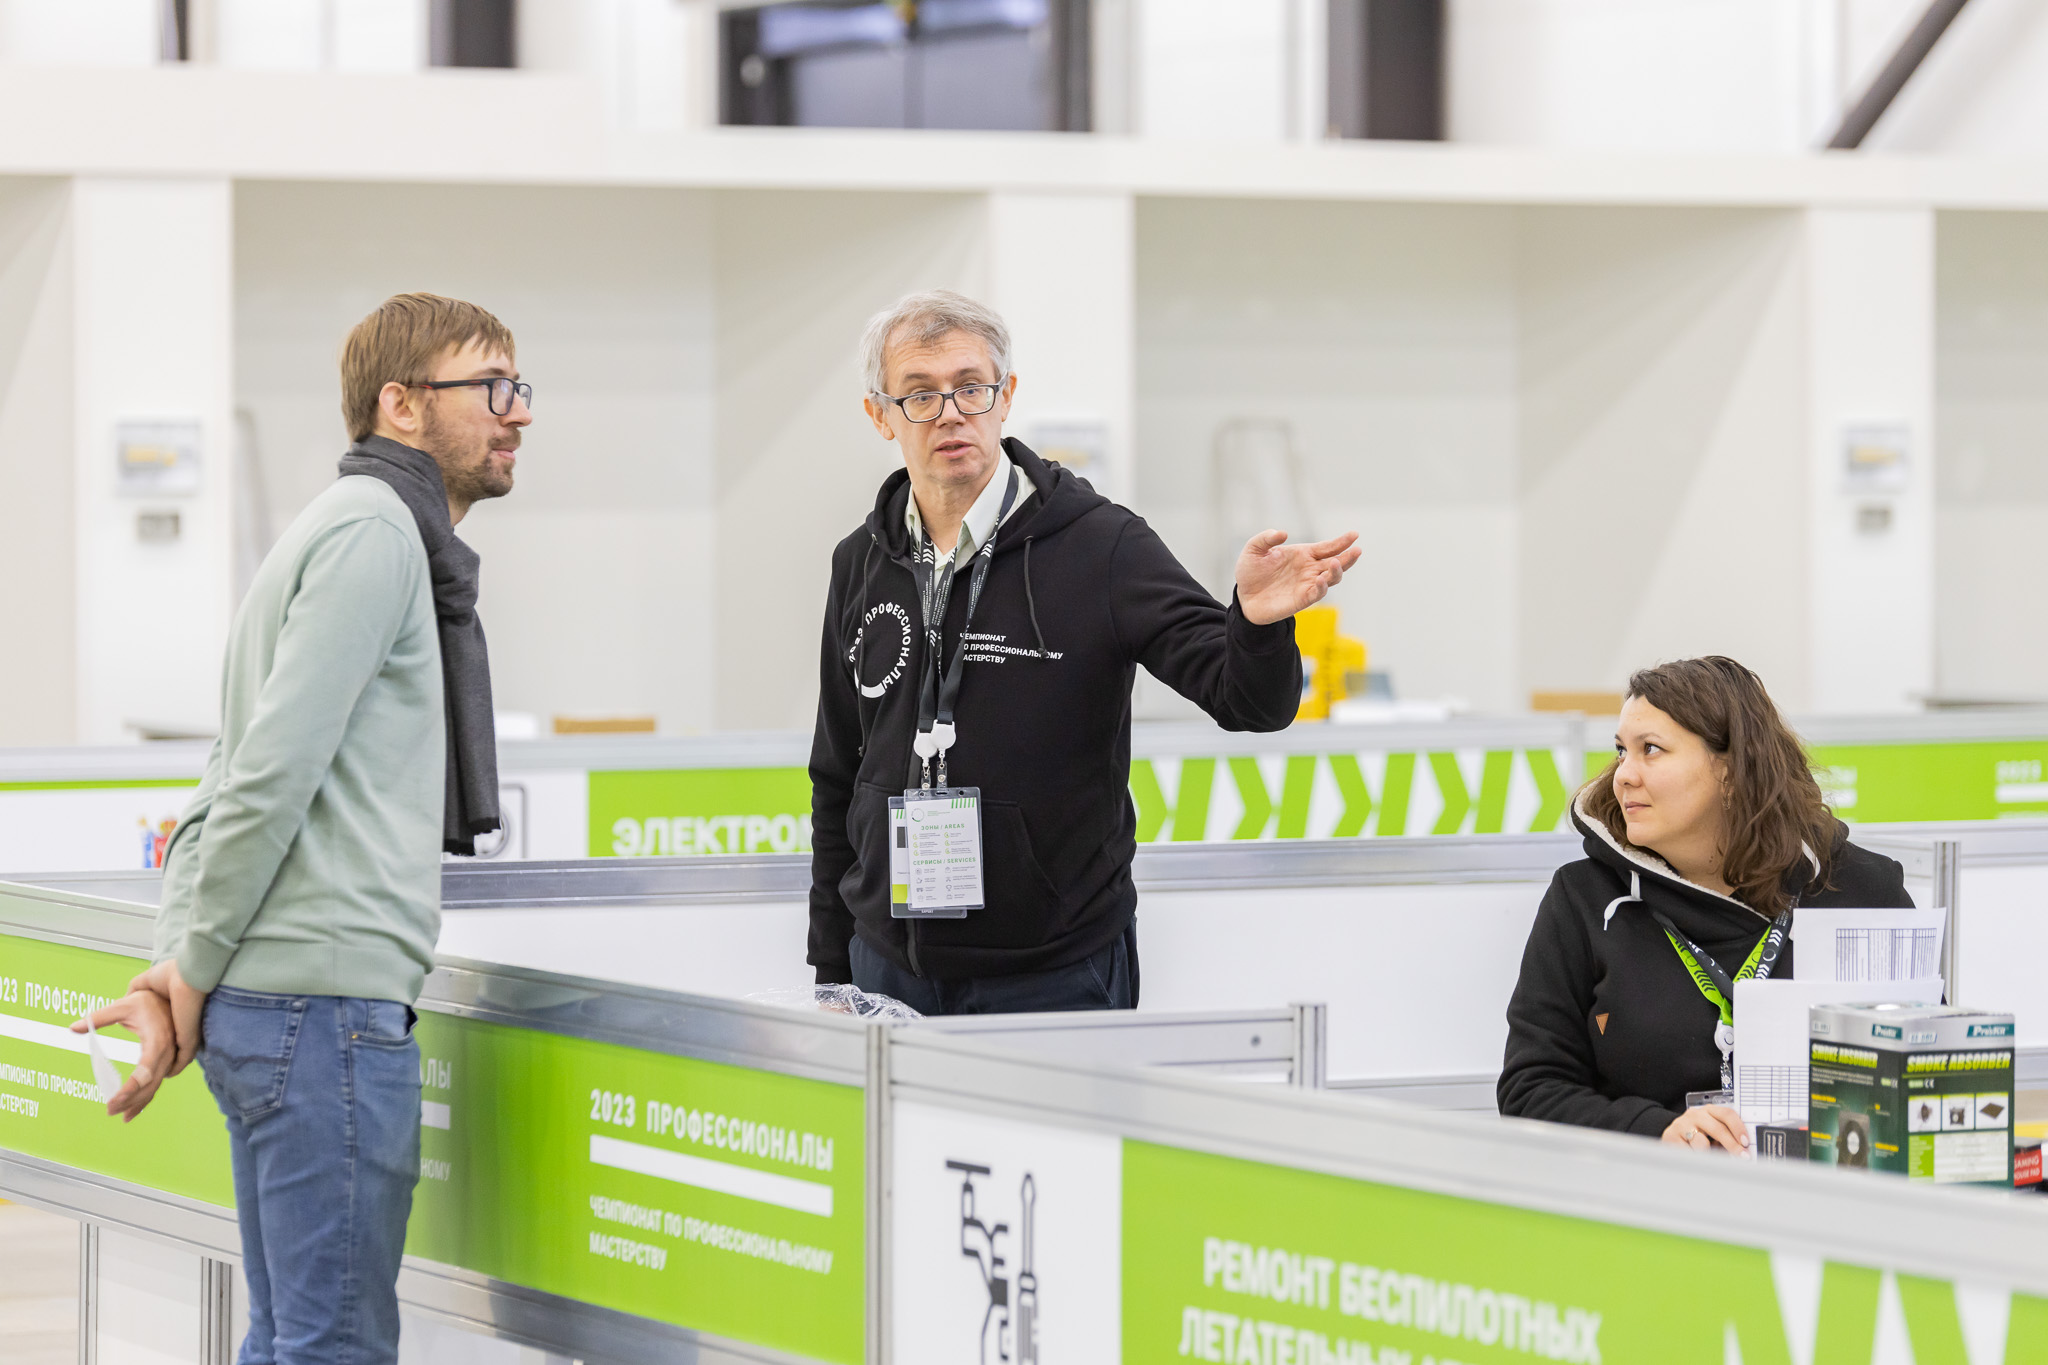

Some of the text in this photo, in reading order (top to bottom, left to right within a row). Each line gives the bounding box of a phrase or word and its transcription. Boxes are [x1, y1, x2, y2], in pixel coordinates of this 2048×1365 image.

[865, 602, 911, 689] ПРОФЕССИОНАЛЫ
[963, 654, 1006, 664] АСТЕРСТВУ
[970, 643, 1063, 660] ПРОФЕССИОНАЛЬОМУ
[0, 975, 18, 1004] 23
[1906, 1051, 2012, 1073] SMOKE ABSORBER
[0, 1063, 36, 1088] МПИОНАТ
[37, 1072, 49, 1091] ПО
[0, 1092, 39, 1118] СТЕРСТВУ
[590, 1088, 834, 1172] 2023 ПРОФЕССИОНАЛЫ
[590, 1195, 834, 1275] ЧЕМПИОНАТ ПО ПРОФЕССИОНАЛЬНОМУ
[589, 1231, 668, 1271] МАСТЕРСТВУ
[1203, 1236, 1603, 1365] РЕМОНТ БЕСПИЛОТНЫХ
